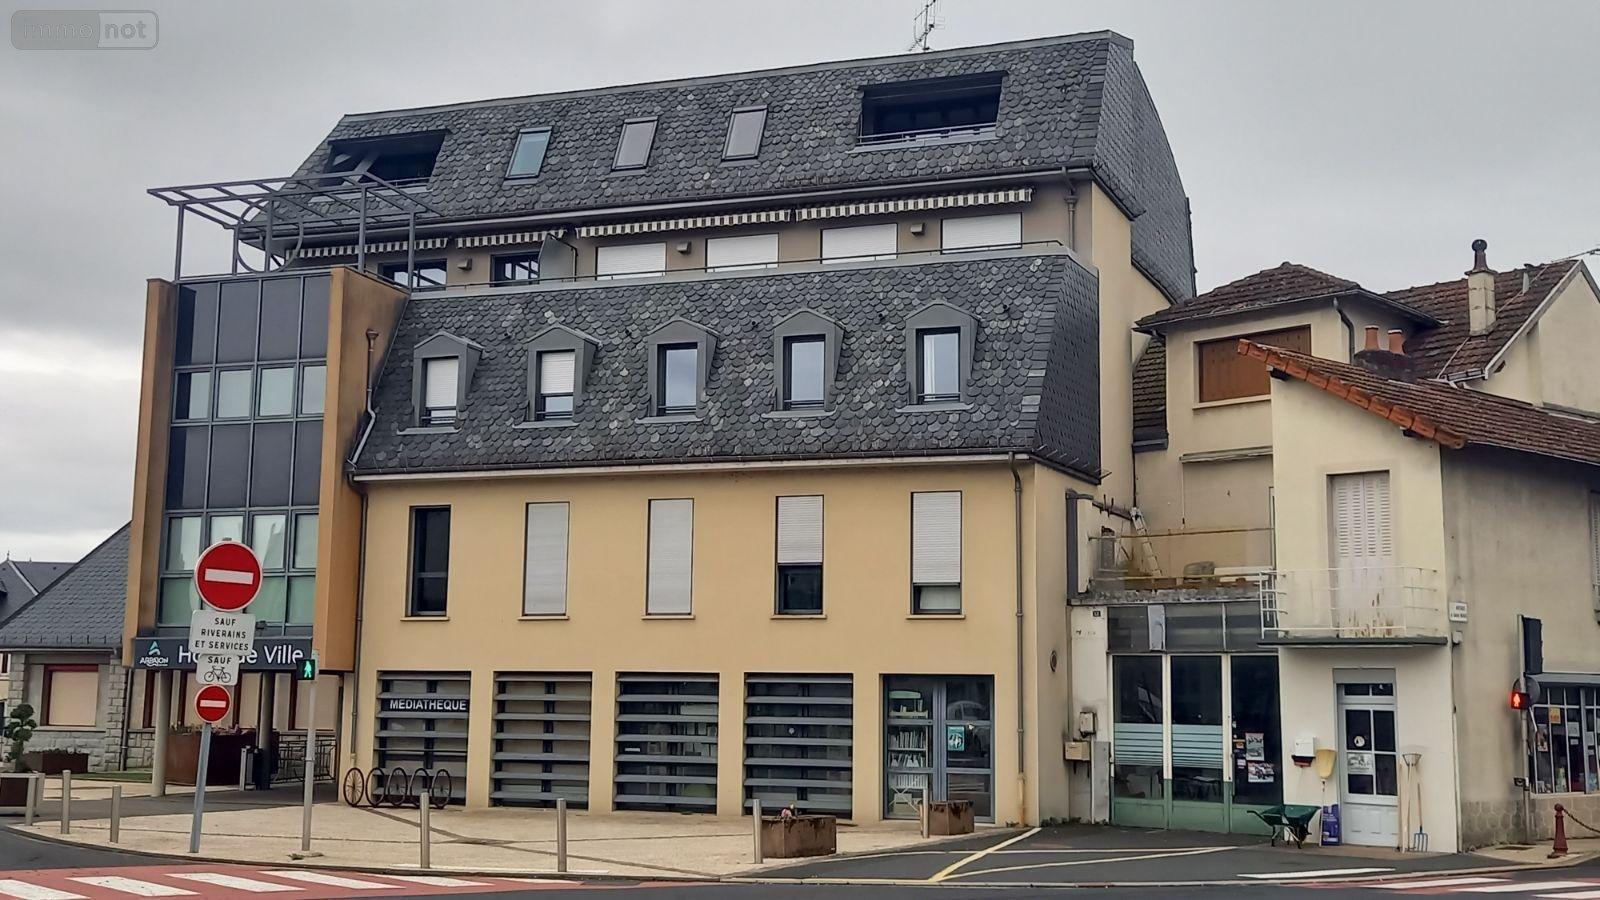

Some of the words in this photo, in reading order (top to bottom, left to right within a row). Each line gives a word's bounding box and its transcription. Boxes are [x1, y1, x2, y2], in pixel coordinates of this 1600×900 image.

[214, 617, 237, 626] SAUF
[201, 628, 247, 639] RIVERAINS
[194, 640, 205, 648] ET
[208, 640, 249, 651] SERVICES
[207, 655, 232, 665] SAUF
[389, 699, 467, 711] MEDIATHEQUE
